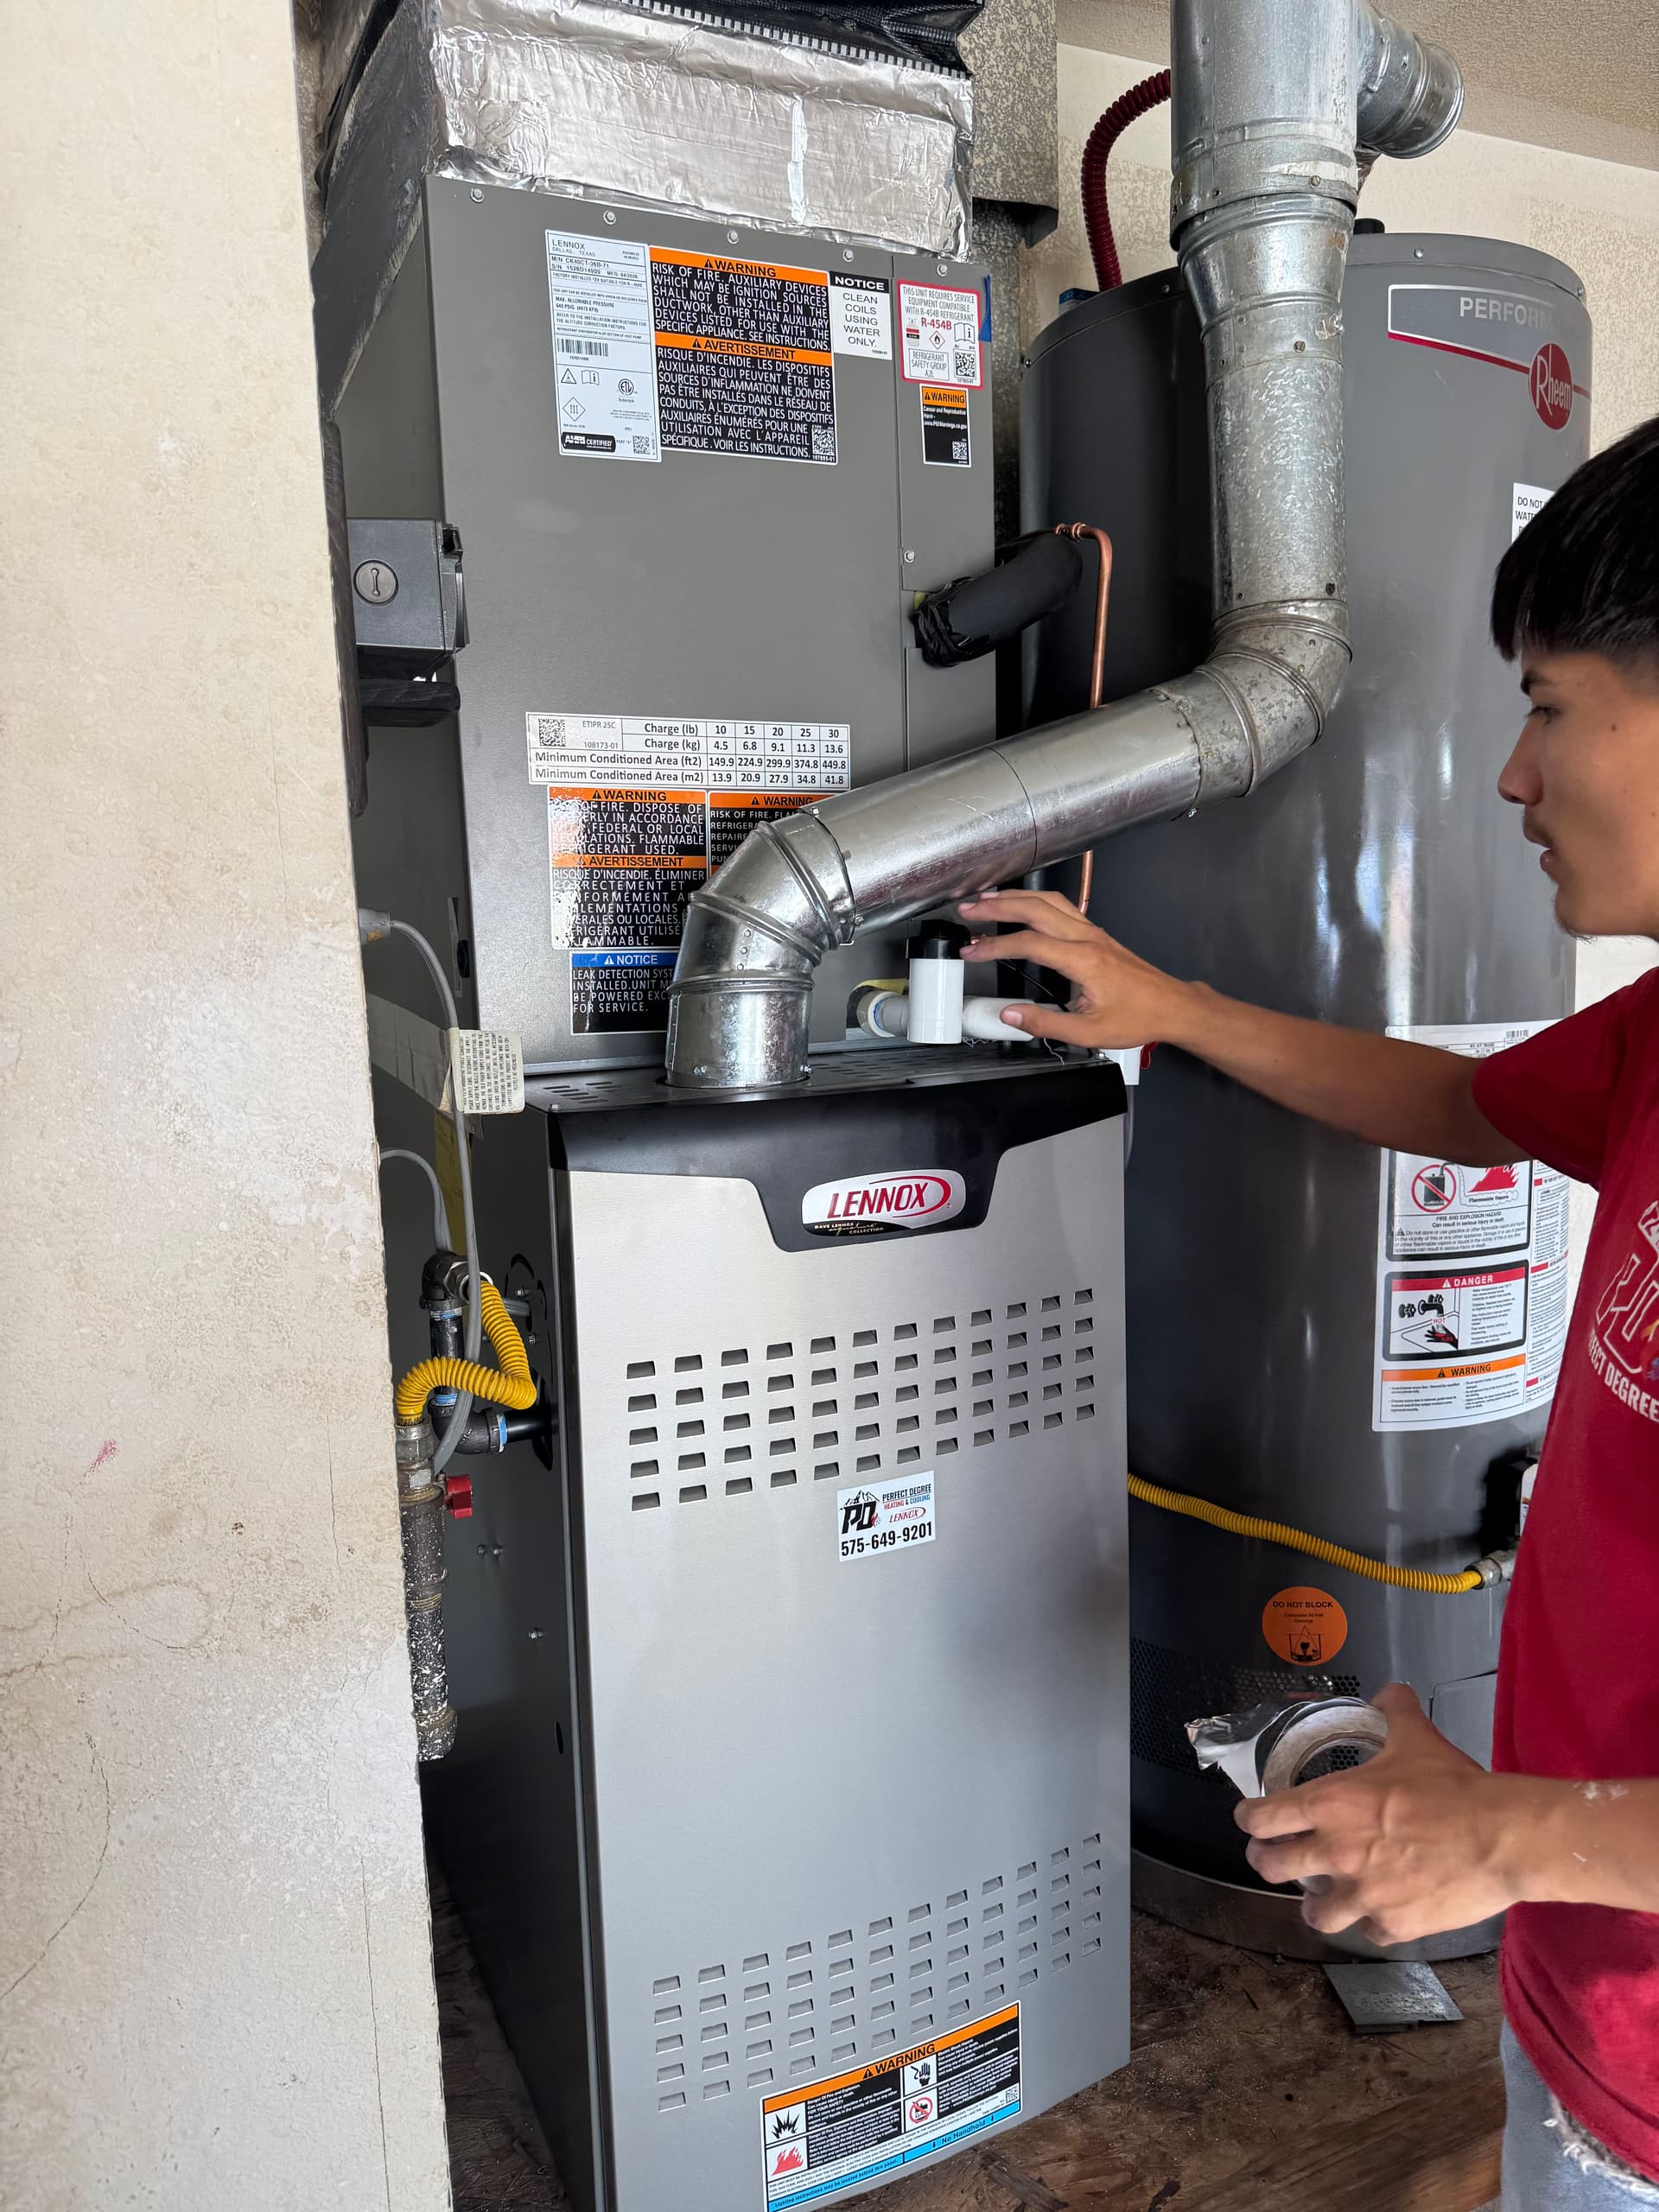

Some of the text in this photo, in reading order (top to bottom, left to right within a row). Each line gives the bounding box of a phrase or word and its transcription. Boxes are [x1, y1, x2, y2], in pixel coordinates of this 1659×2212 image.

[553, 239, 585, 250] LENNOX
[715, 259, 776, 277] WARNING
[652, 263, 826, 296] RISK OF FIRE. AUXILIARY DEVICES
[836, 276, 884, 290] NOTICE
[653, 274, 688, 289] WHICH
[694, 280, 715, 293] MAY
[719, 283, 729, 295] BE
[734, 285, 777, 301] IGNITION
[784, 292, 826, 308] SOURCES
[929, 290, 953, 301] REQUIRES
[955, 294, 974, 303] SERVICE
[653, 286, 686, 300] SHALL
[690, 291, 710, 303] NOT
[717, 295, 728, 306] BE
[735, 296, 789, 314] INSTALLED
[793, 304, 803, 315] IN
[810, 306, 827, 319] THE
[843, 293, 877, 304] CLEAN
[909, 297, 969, 312] EQUIPMENT COMPATIBLE
[655, 297, 829, 329] DUCTWORK, OTHER THAN AUXILIARY
[845, 304, 876, 315] COILS
[906, 306, 973, 321] WITH R-454B REFRIGERANT
[845, 315, 878, 325] USING
[921, 318, 952, 330] R-454B
[844, 325, 880, 336] WATER
[849, 336, 876, 347] ONLY.
[704, 341, 795, 359] AVERTISSEMENT
[658, 348, 830, 377] RISQUE D'INCENDIE. LES DISPOSITIFS
[913, 352, 944, 361] REFRIGERANT
[912, 359, 946, 370] SAFETY GROUP
[1536, 345, 1571, 416] Rheem
[931, 393, 964, 404] WARNING
[1518, 497, 1542, 509] DO NOT
[645, 723, 679, 735] Charge
[683, 724, 698, 736] (lb)
[744, 726, 754, 734] 15
[772, 728, 783, 736] 20
[801, 728, 810, 737] 25
[829, 729, 839, 738] 30
[645, 739, 843, 753] Charge (kg) 4.5 6.8 9.1 11.3 13.6
[536, 752, 846, 769] Minimum Conditioned Area (ft2) 149.9 224.9 299.9 374.8 449.8
[536, 768, 843, 785] Minimum Conditioned Area (m2) 13.9 20.9 27.9 34.8 41.8
[603, 790, 666, 801] WARNING
[764, 797, 813, 806] WARNING
[601, 802, 702, 813] FIRE. DISPOSE OF
[613, 813, 702, 824] IN ACCORDANCE
[593, 823, 703, 835] FEDERAL OR LOCAL
[639, 835, 704, 845] FLAMMABLE
[645, 845, 679, 855] USED.
[589, 856, 683, 867] AVERTISSEMENT
[617, 955, 658, 964] NOTICE
[574, 969, 650, 980] LEAK DETECTION
[574, 991, 643, 1002] BE POWERED
[574, 1002, 648, 1013] FOR SERVICE.
[827, 1183, 929, 1219] LENNOX
[1454, 1275, 1493, 1287] DANGER
[1452, 1364, 1491, 1376] WARNING
[882, 1484, 931, 1502] PERFECT DEGREE
[884, 1500, 904, 1510] HEATING
[910, 1494, 931, 1504] COOLING
[890, 1510, 919, 1523] LENNOX
[842, 1522, 932, 1557] 575-649-9201
[876, 2044, 935, 2074] WARNING
[953, 2120, 985, 2139] Handhold
